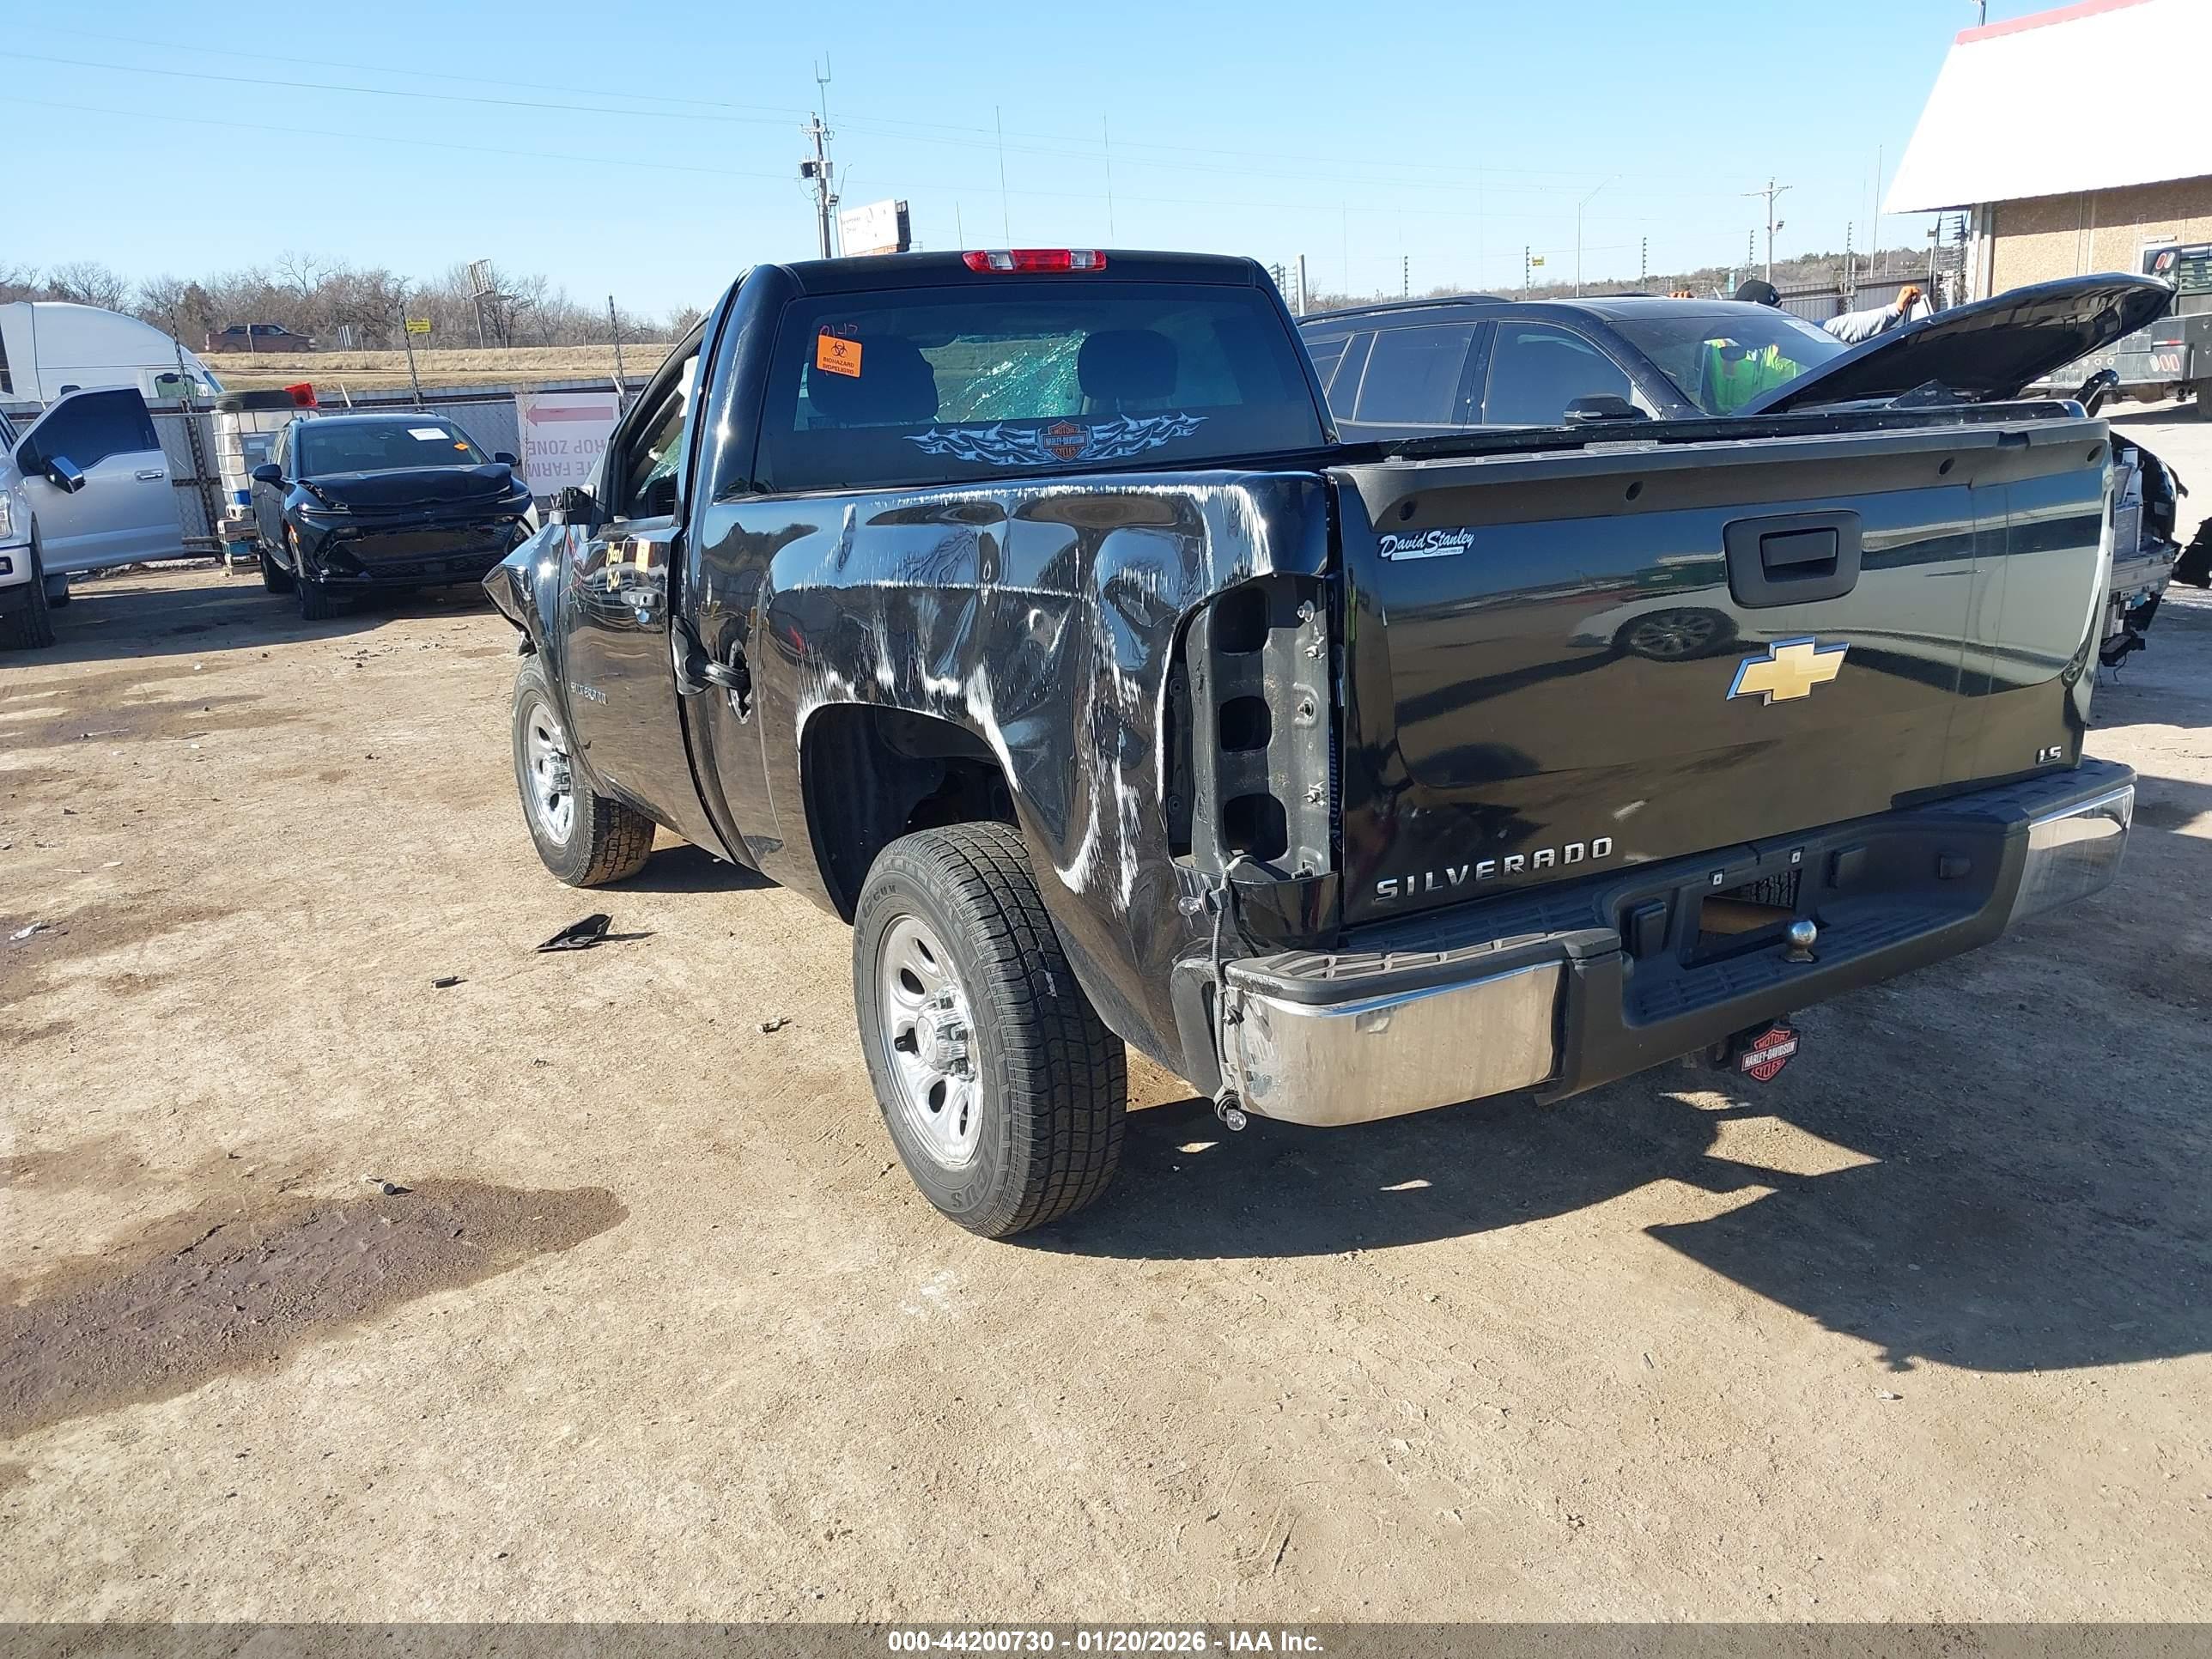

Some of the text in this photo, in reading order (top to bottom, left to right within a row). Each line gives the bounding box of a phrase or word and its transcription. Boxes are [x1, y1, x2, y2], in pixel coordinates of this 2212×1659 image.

[823, 357, 854, 368] BIOHAZARD
[527, 439, 605, 456] ROP ZONE
[527, 461, 571, 477] FARM
[1380, 527, 1475, 557] David Stanley
[2037, 744, 2062, 763] LS
[1373, 836, 1613, 902] SILVERADO
[1758, 1034, 1786, 1048] MOTOR
[1744, 1041, 1796, 1068] HARLEY-DAVIDSON
[1754, 1058, 1784, 1078] CYCLES
